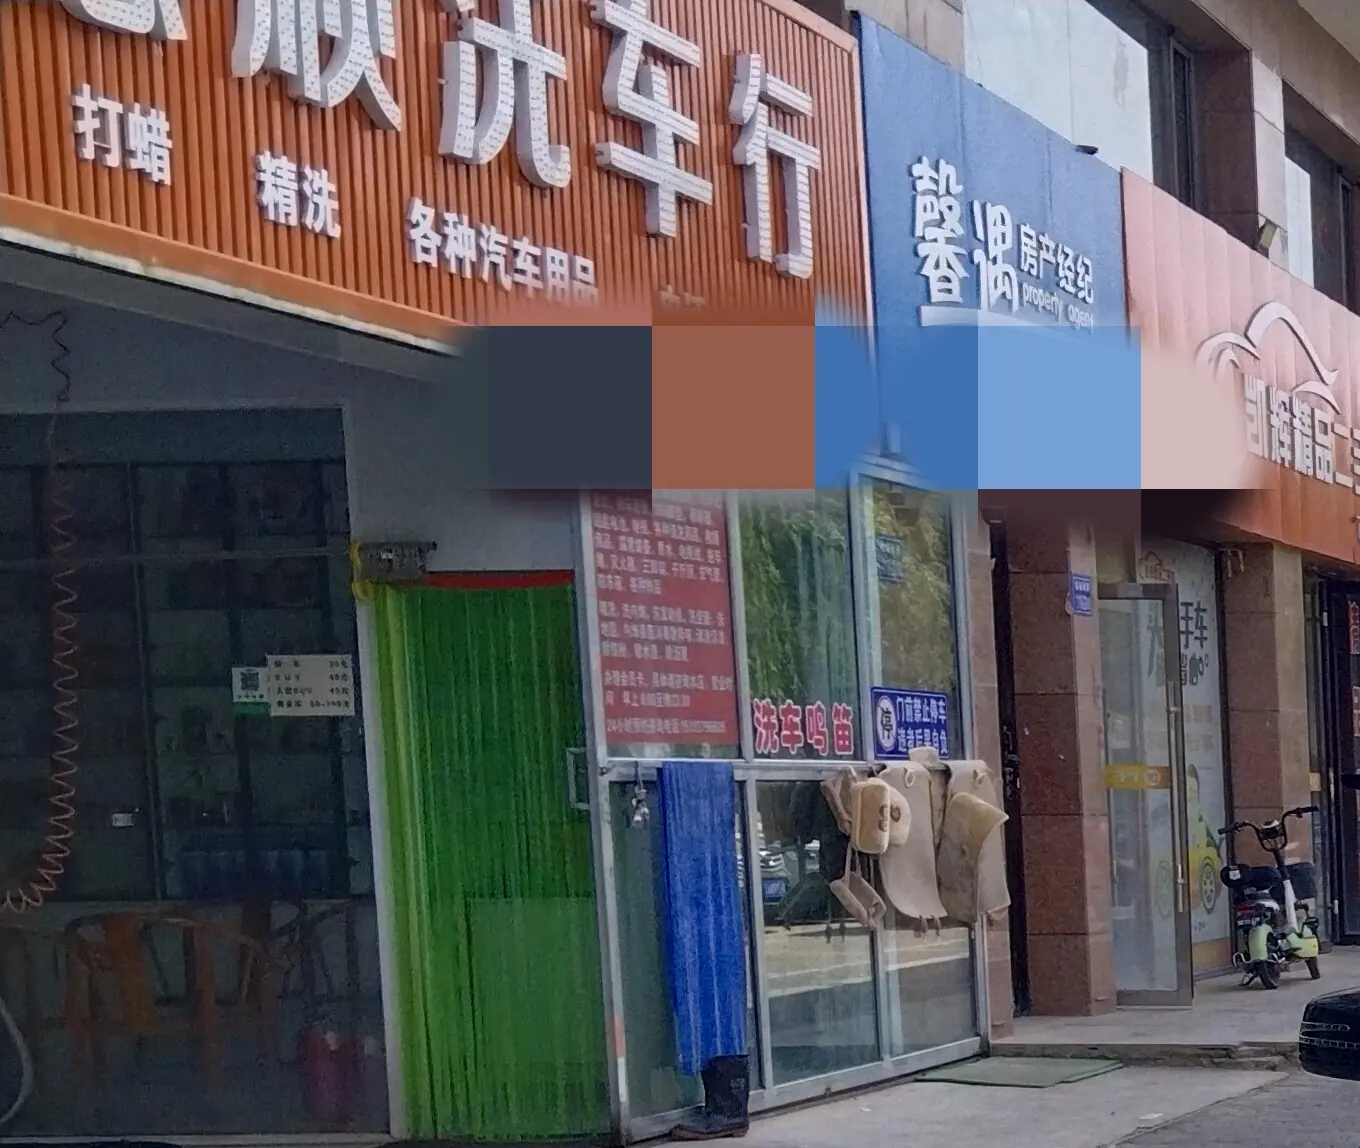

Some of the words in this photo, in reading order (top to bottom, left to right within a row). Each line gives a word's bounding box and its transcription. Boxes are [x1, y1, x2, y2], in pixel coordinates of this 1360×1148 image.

[62, 0, 820, 279] 洗车行
[72, 83, 172, 186] 打蜡
[256, 149, 341, 239] 精洗
[407, 196, 599, 299] 各种汽车用品
[1019, 222, 1094, 304] 房产经纪
[1022, 283, 1063, 321] property
[1067, 305, 1094, 333] agent
[753, 698, 854, 756] 洗车鸣笛
[879, 705, 894, 740] 停
[896, 695, 947, 725] 门前禁止停车
